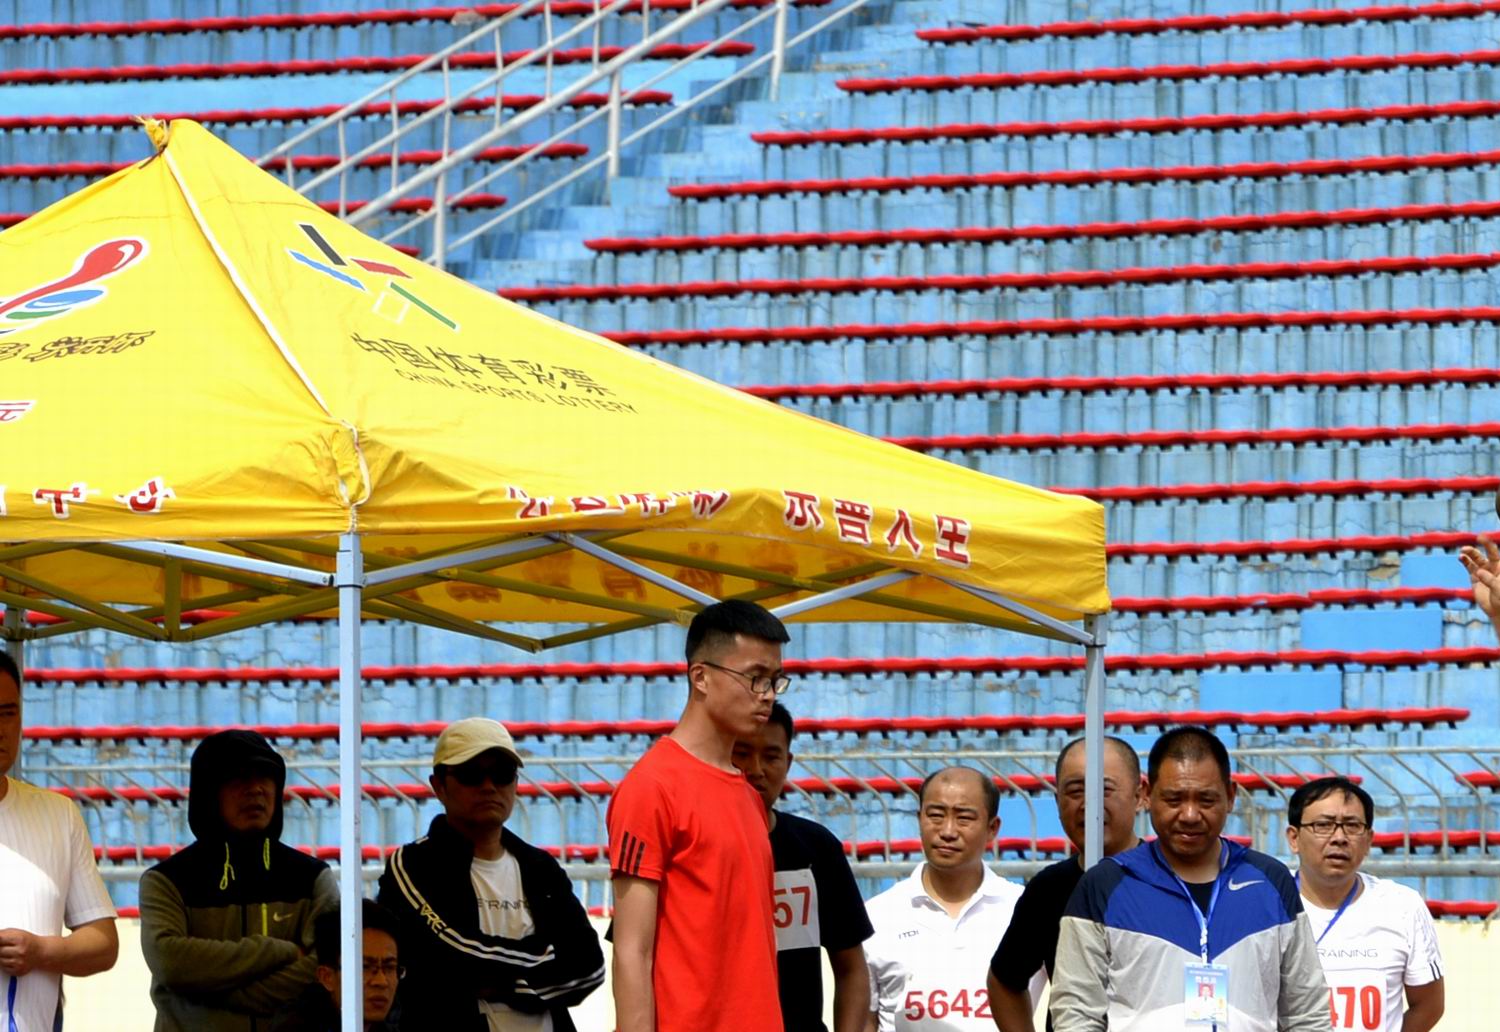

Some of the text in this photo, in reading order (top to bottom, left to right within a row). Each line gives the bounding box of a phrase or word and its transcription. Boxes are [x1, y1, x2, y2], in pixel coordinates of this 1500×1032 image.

[351, 332, 616, 396] 中国体育彩票
[395, 368, 639, 414] CHINA SPORTS LOTTERY
[904, 988, 994, 1021] 5642
